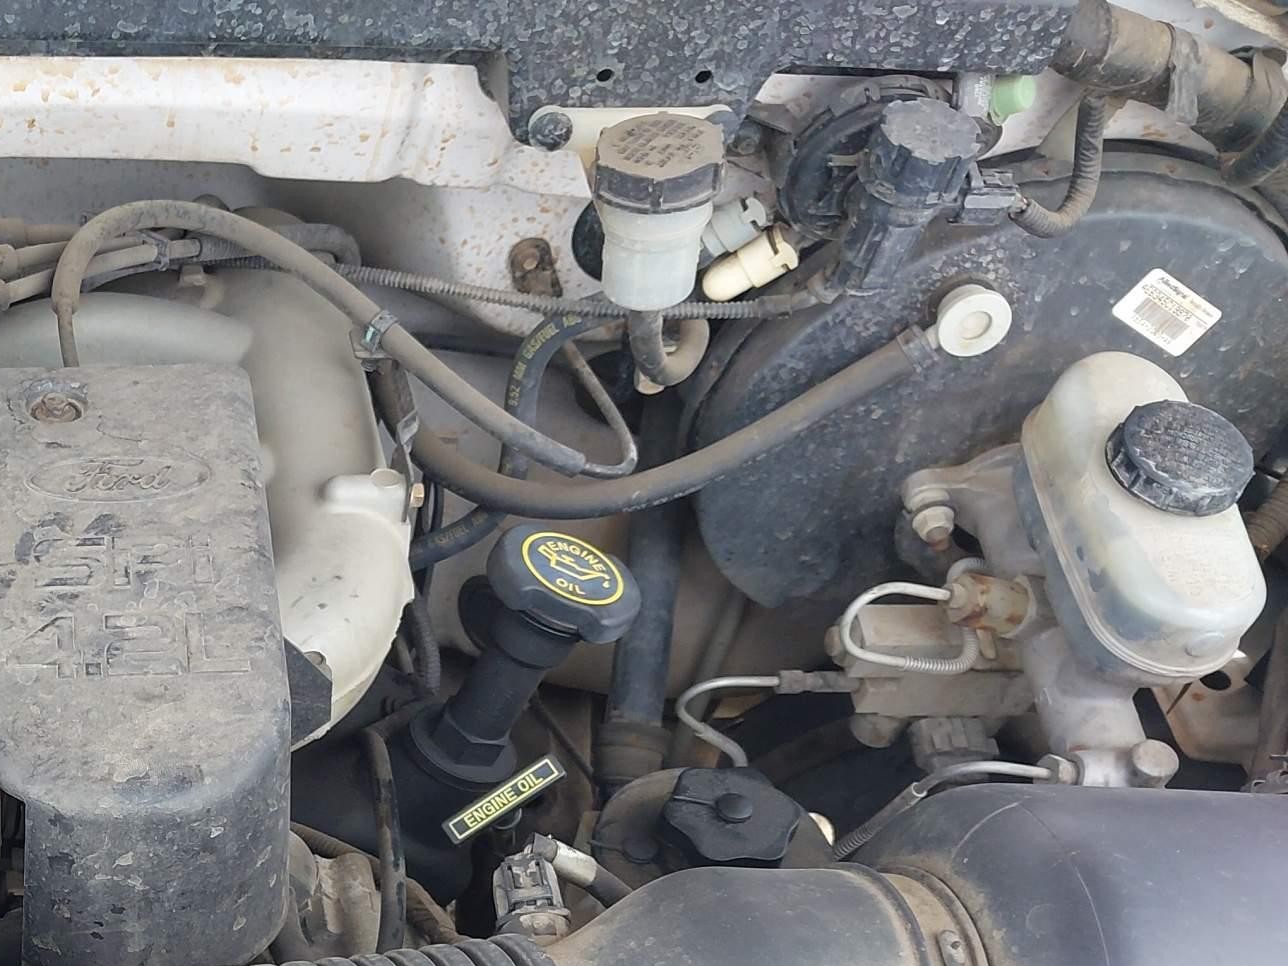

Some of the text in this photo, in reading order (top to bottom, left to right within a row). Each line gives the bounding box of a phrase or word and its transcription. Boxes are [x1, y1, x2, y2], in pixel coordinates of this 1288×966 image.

[66, 456, 172, 493] Ford
[546, 541, 607, 572] ENGINE
[555, 578, 587, 596] OIL
[13, 611, 252, 681] 4.2L
[463, 773, 544, 828] ENGINE OIL
